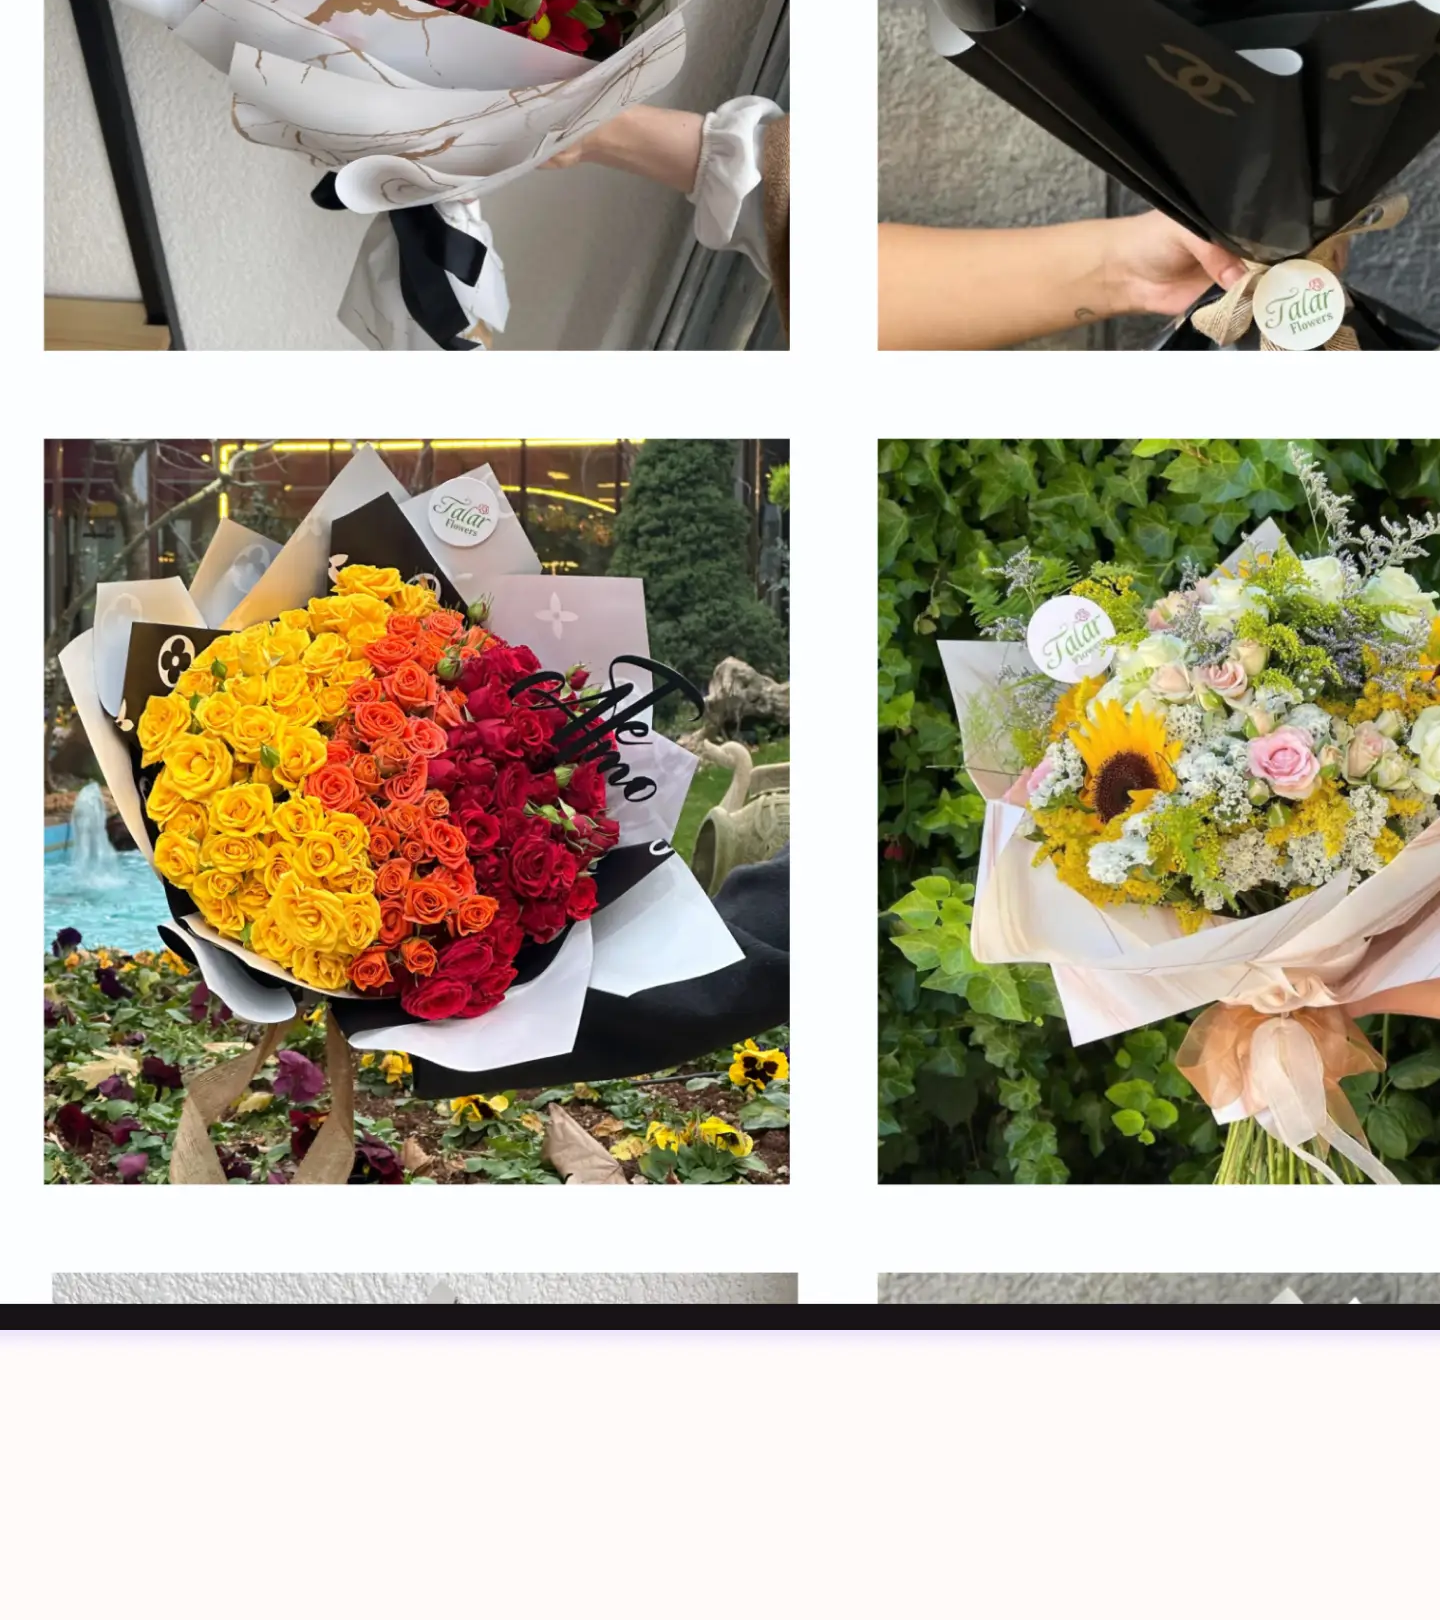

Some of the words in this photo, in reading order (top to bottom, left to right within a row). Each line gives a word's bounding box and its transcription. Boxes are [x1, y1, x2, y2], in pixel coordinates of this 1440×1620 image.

[1264, 287, 1335, 329] Talar
[1289, 312, 1334, 335] Flowers
[433, 495, 491, 529] Talar
[1043, 614, 1101, 670] Talar
